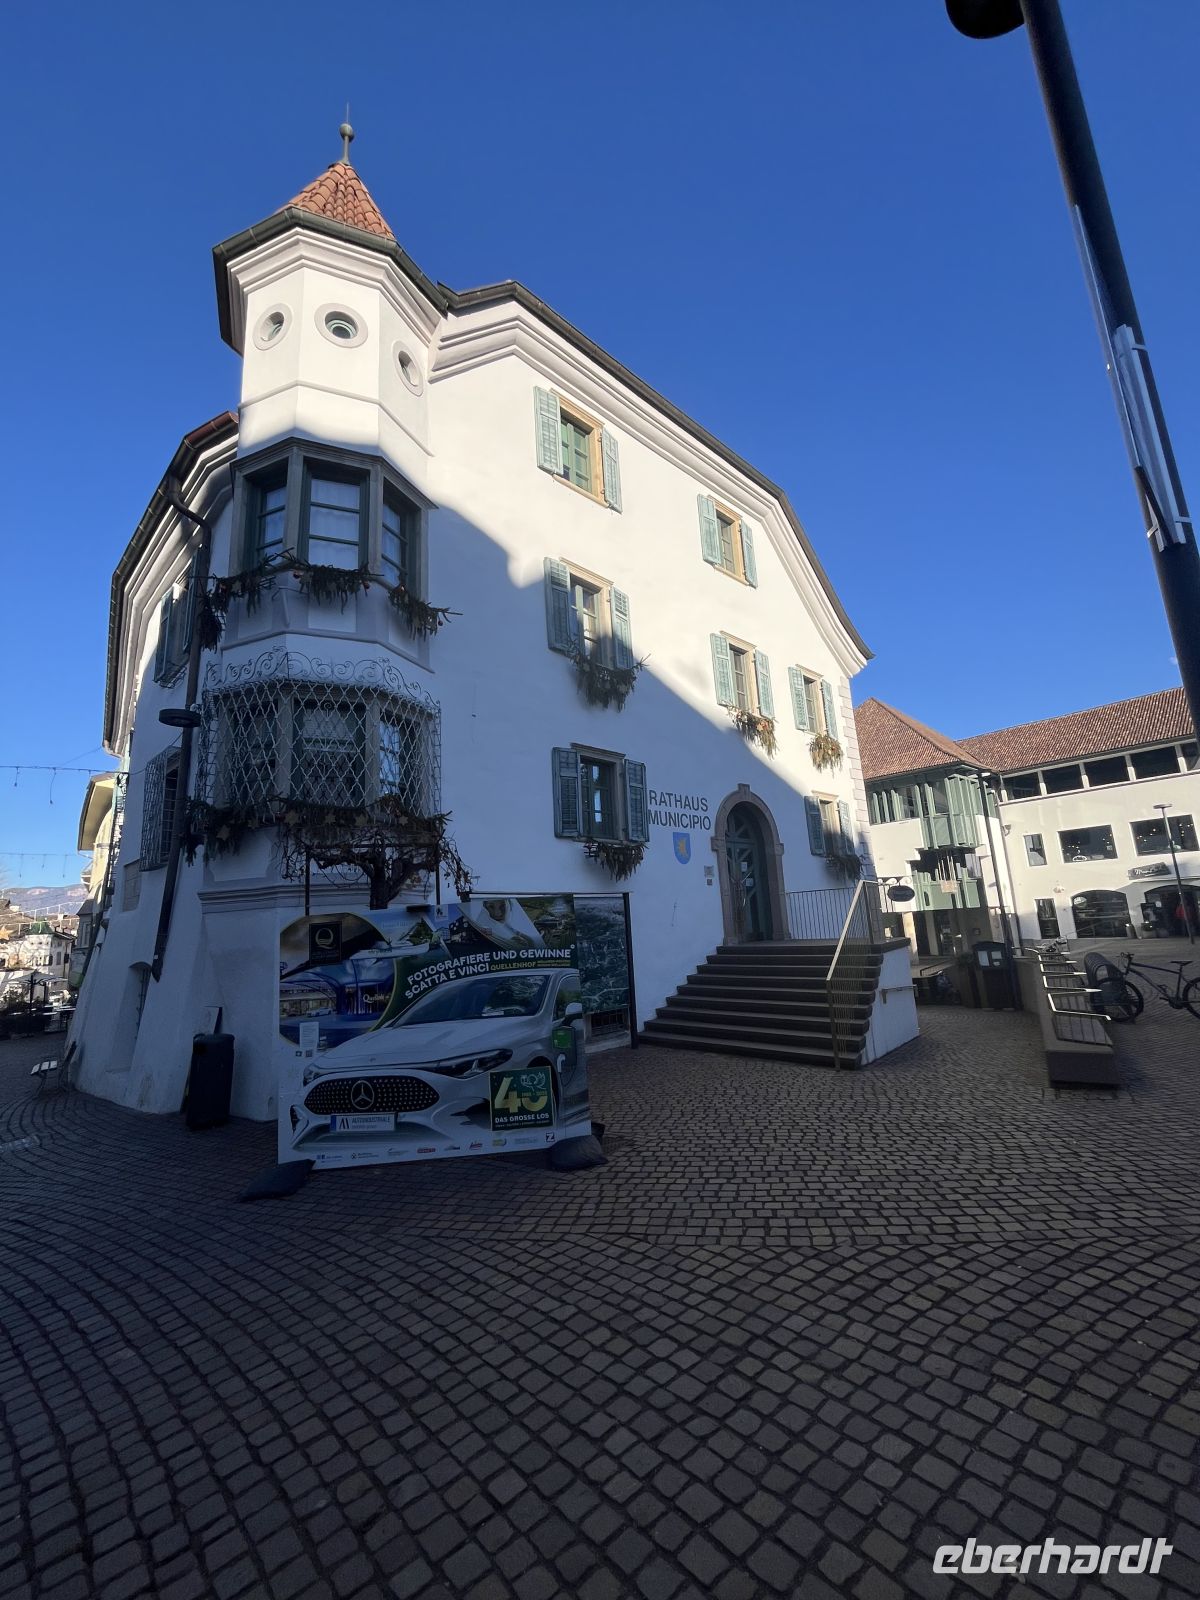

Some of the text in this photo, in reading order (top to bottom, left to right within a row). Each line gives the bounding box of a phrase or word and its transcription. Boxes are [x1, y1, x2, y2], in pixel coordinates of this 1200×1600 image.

[648, 789, 709, 813] RATHAUS
[648, 809, 712, 831] MUNICIPIO
[406, 948, 572, 986] FOTOGRAFIERE UND GEWINNE
[490, 961, 537, 971] QUELLENHOF
[404, 973, 448, 1000] SCATTA
[449, 968, 457, 979] E
[457, 962, 490, 977] VINCI
[509, 1114, 536, 1122] GROSSE
